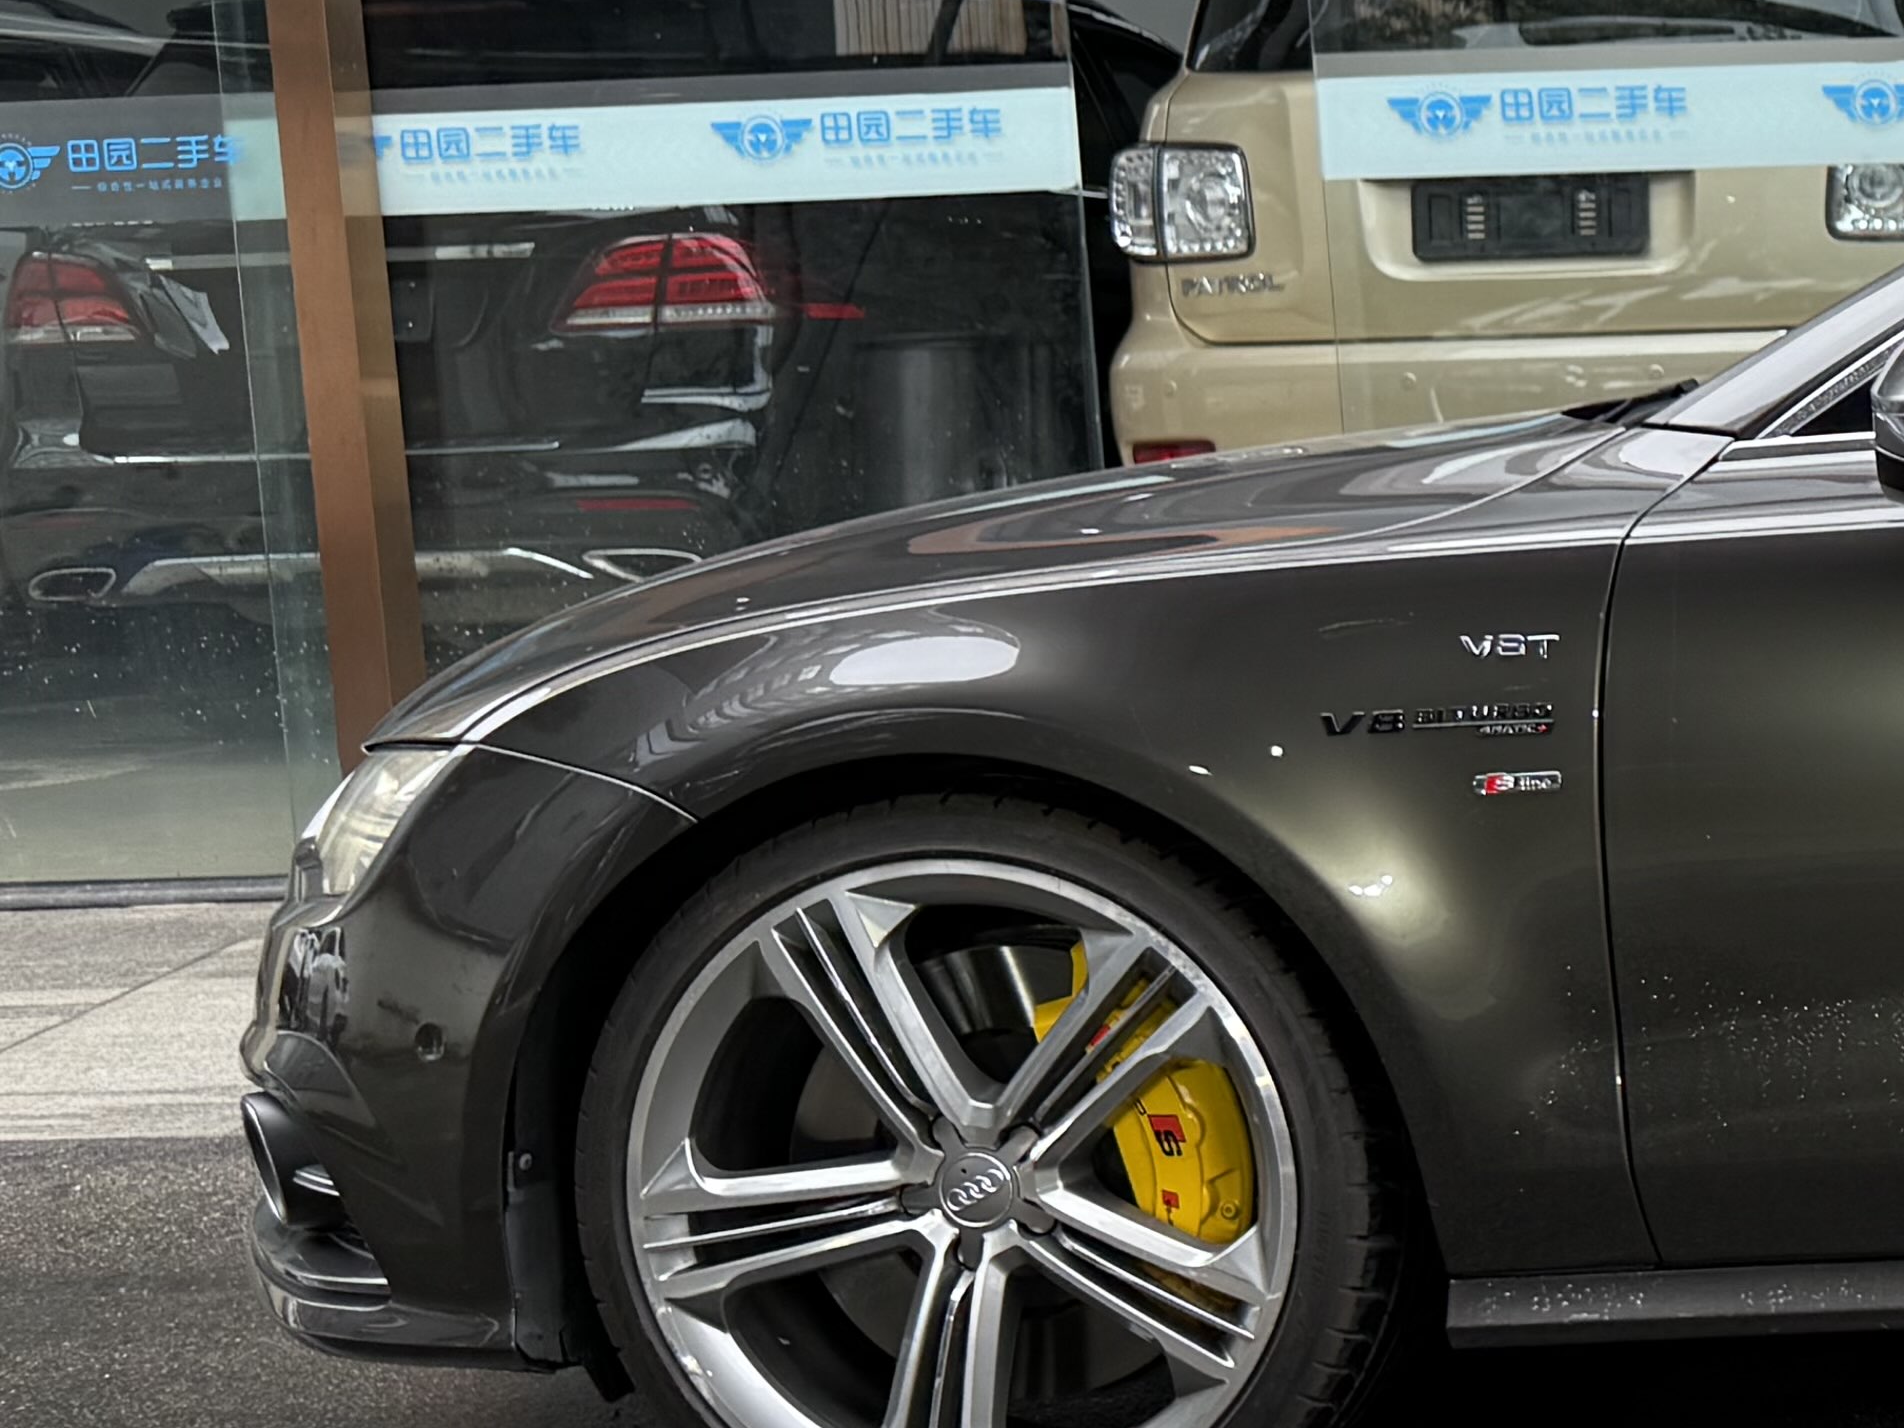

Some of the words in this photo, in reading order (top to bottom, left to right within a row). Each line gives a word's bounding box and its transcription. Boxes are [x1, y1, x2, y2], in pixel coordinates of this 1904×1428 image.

[1499, 84, 1687, 123] 田园二手车
[400, 122, 582, 161] 田园二手车
[819, 107, 1002, 144] 田园二手车
[66, 134, 241, 172] 田园二手车
[1320, 709, 1406, 737] V8
